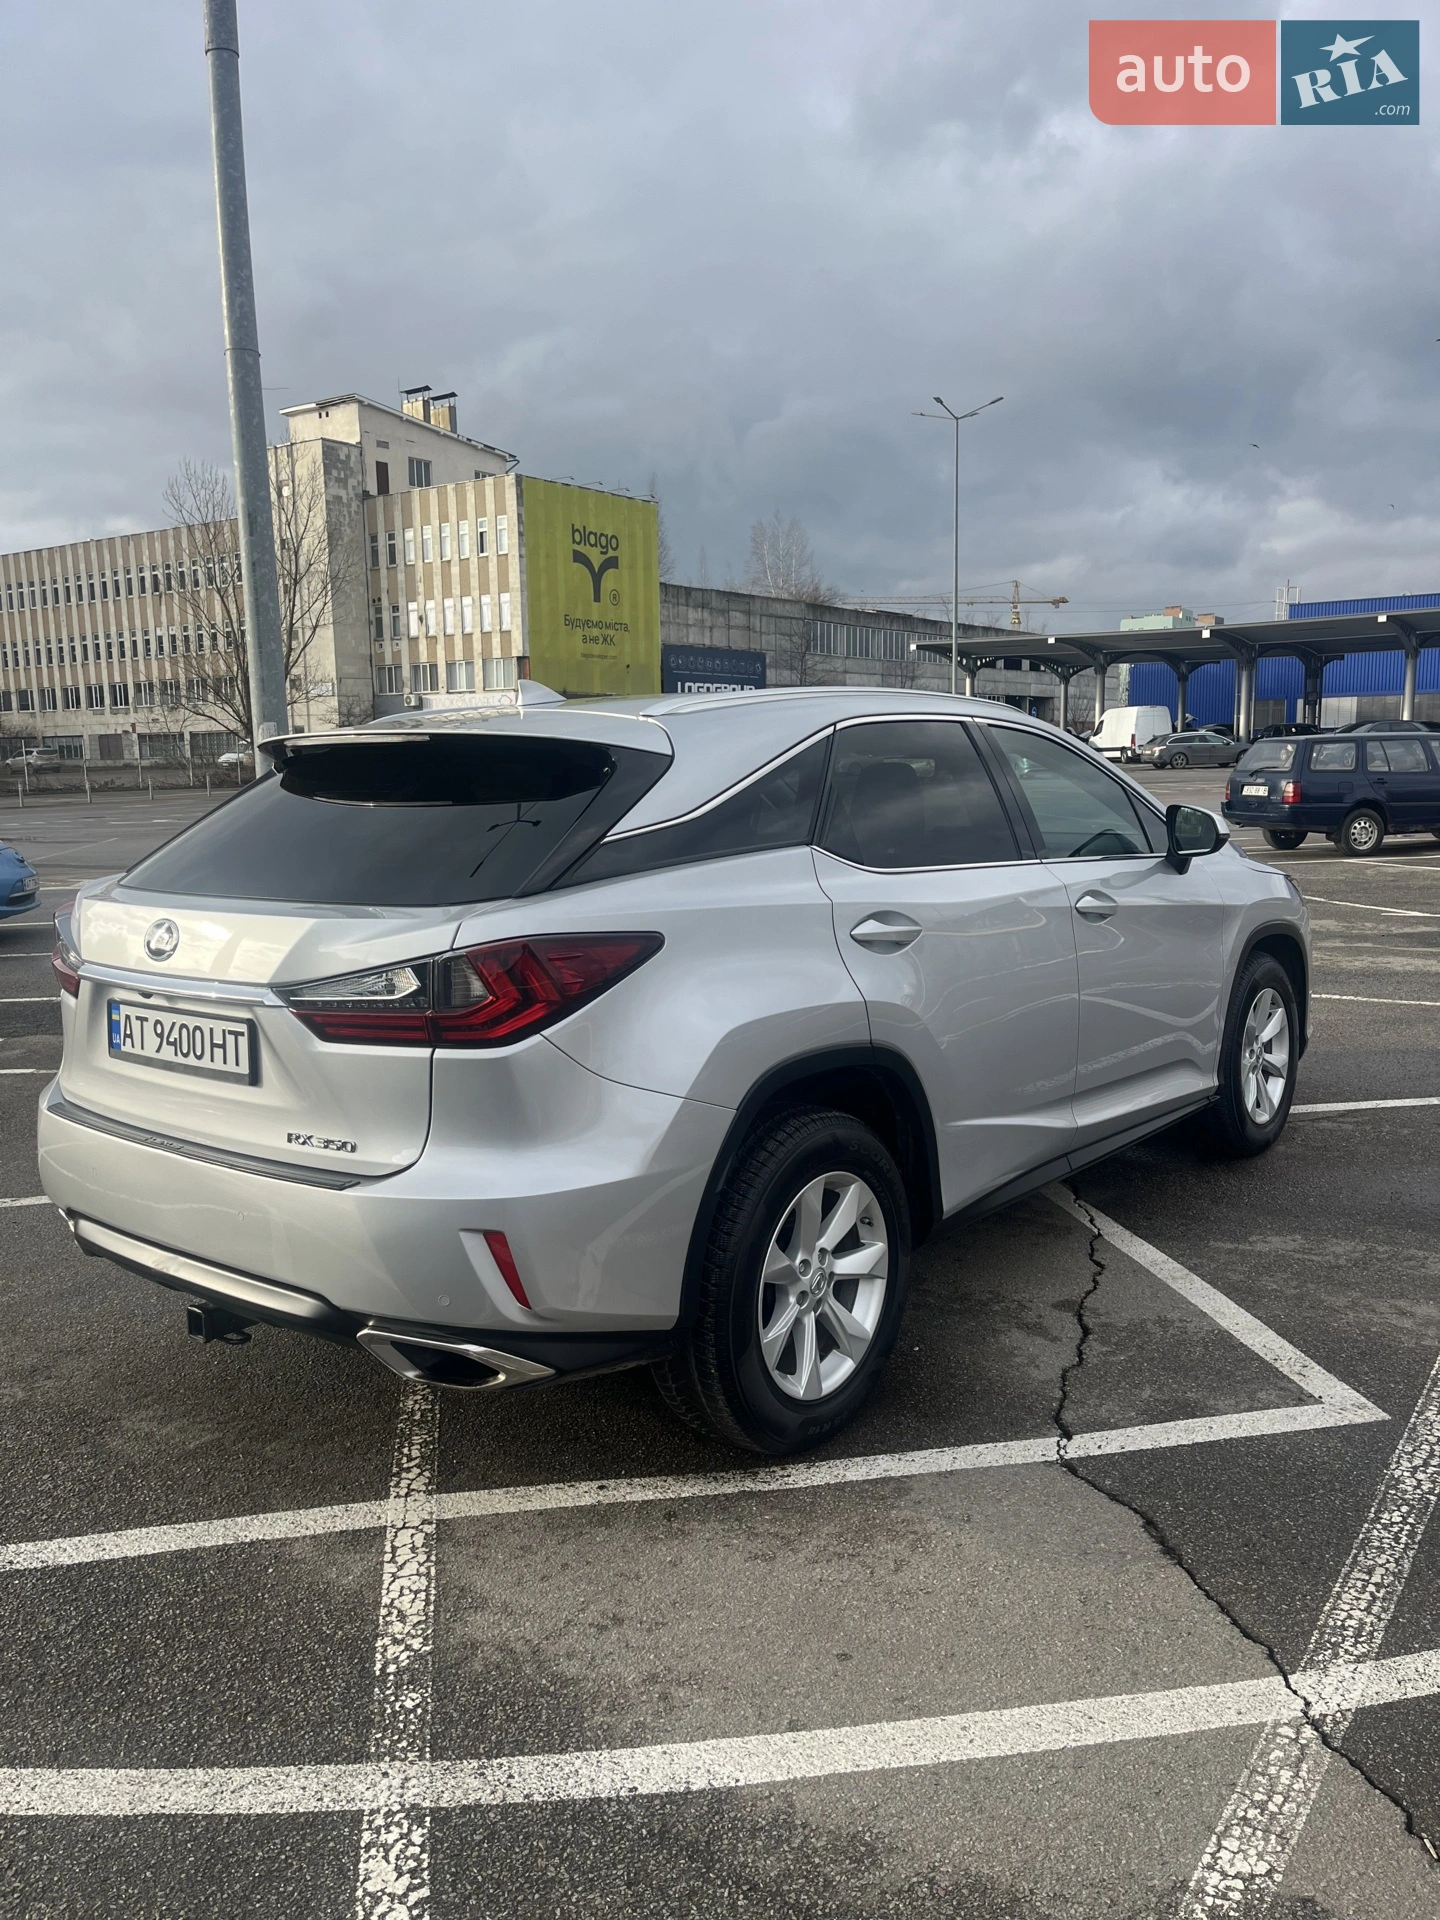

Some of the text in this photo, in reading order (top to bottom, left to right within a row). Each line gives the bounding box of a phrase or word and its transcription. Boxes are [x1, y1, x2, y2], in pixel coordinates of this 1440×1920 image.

[571, 523, 619, 555] blago
[564, 614, 630, 634] Будуємо міста,
[581, 633, 616, 647] а не ЖК
[112, 1033, 121, 1044] UA
[122, 1013, 245, 1067] AT 9400 HT
